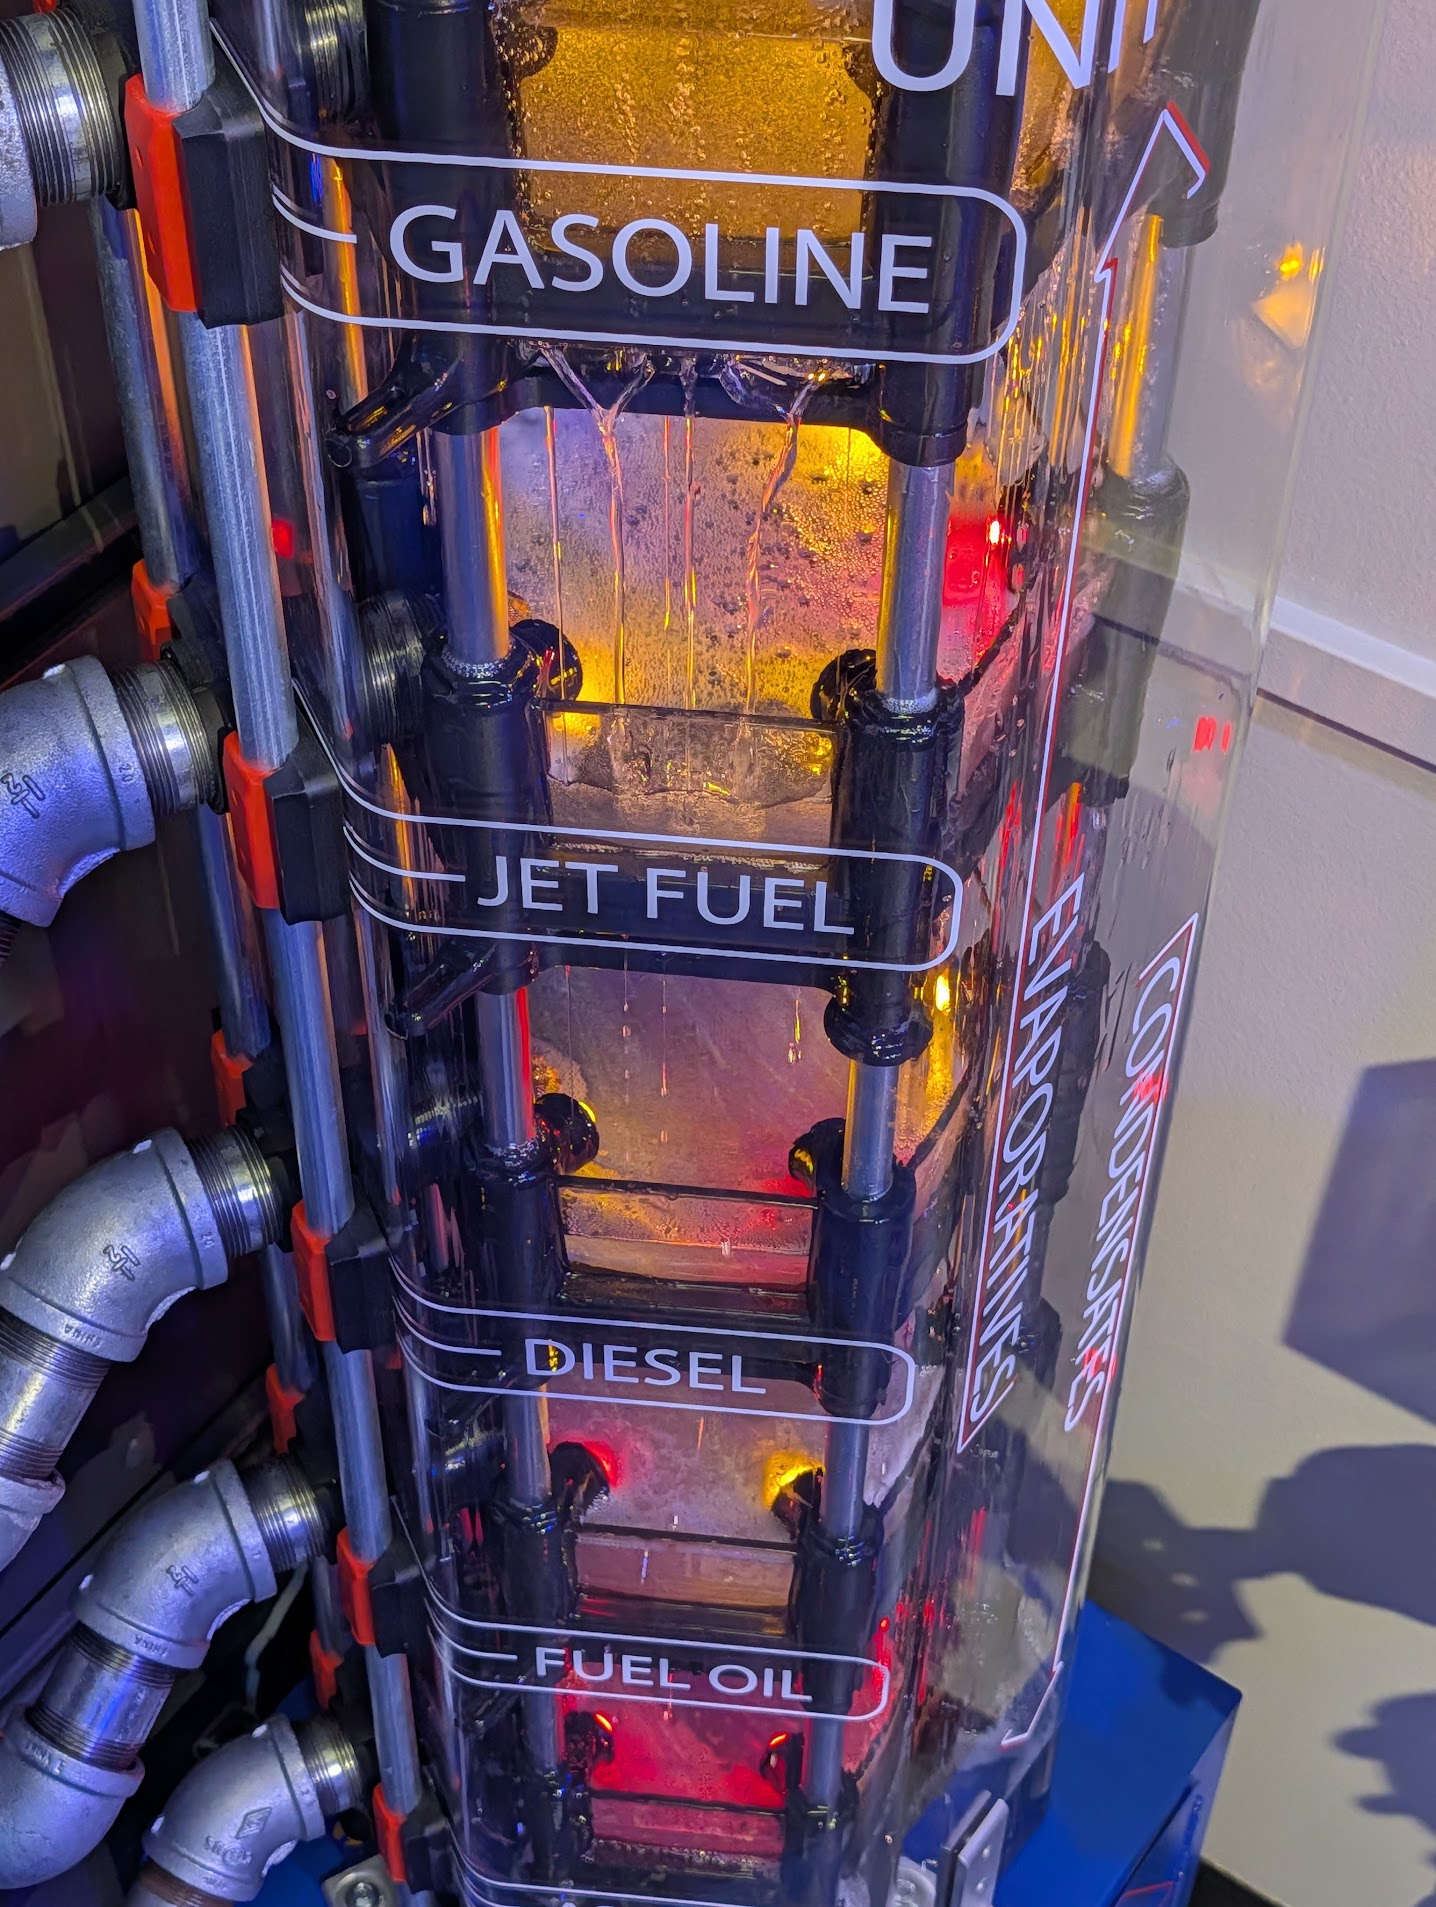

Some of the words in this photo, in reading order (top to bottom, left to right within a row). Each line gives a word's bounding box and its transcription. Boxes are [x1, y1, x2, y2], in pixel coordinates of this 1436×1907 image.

[871, 0, 1158, 97] UNI
[389, 204, 932, 314] GASOLINE
[477, 855, 619, 914] JET
[646, 867, 855, 935] FUEL
[970, 872, 1085, 1423] EVAPORATIVES
[1065, 956, 1181, 1432] CONDENSATES
[524, 1338, 767, 1395] DIESEL
[535, 1646, 691, 1690] FUEL
[708, 1664, 813, 1702] OIL
